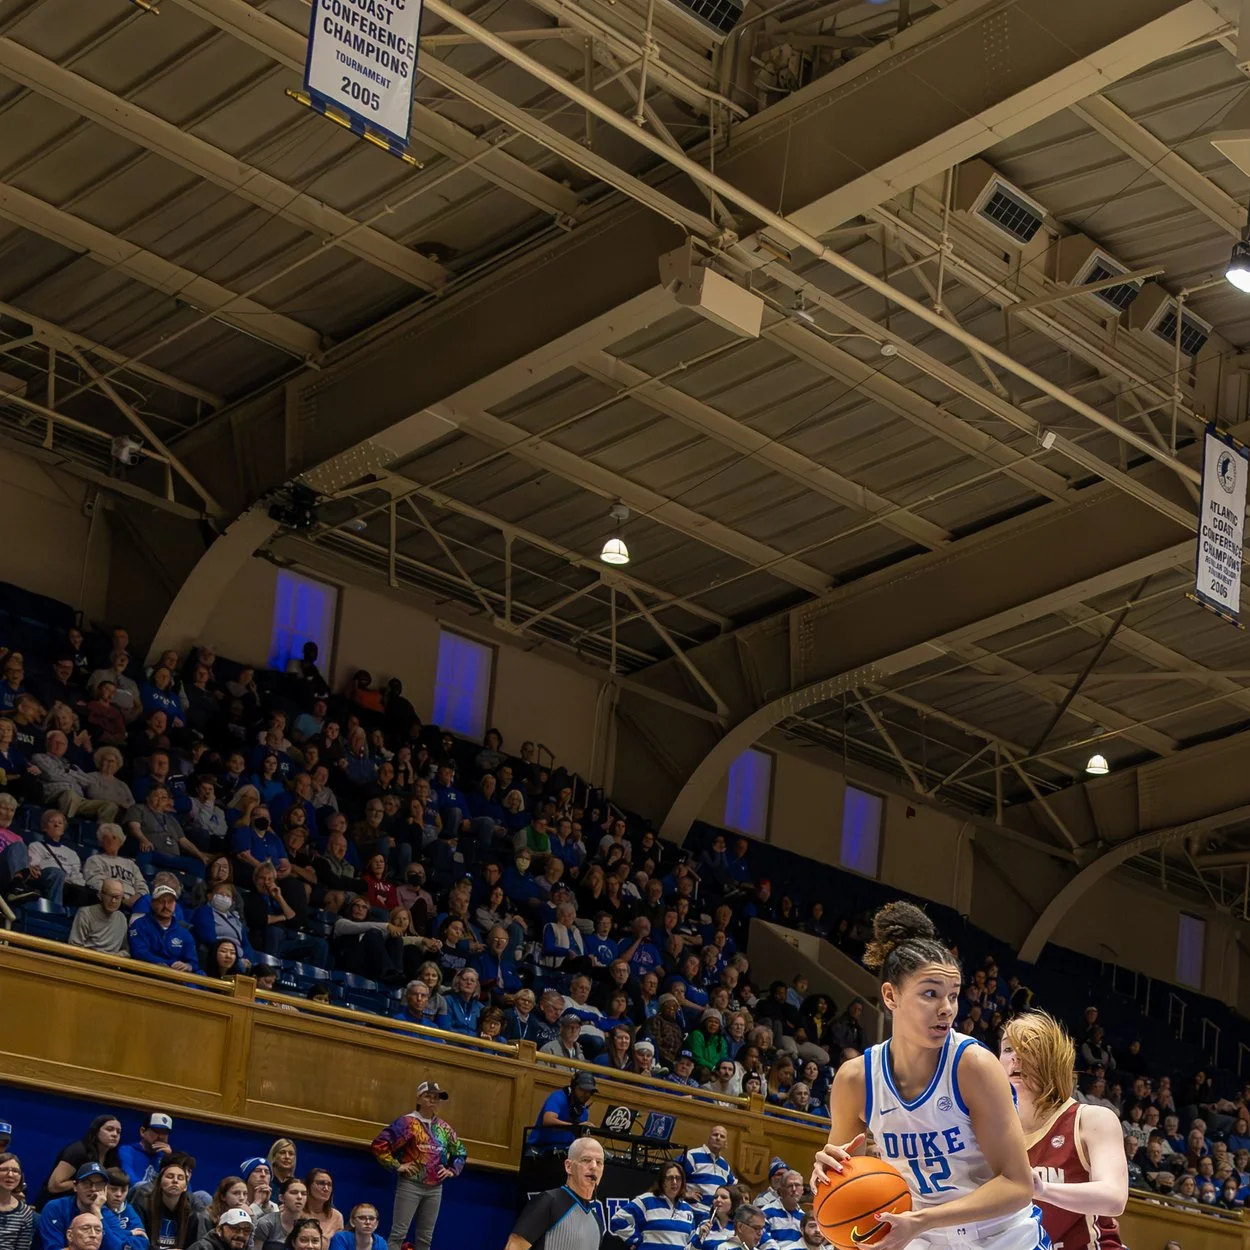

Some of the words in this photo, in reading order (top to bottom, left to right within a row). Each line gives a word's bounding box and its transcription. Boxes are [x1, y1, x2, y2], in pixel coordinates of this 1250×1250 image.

[349, 0, 394, 25] OAST
[321, 0, 415, 61] CONFERENCE
[323, 17, 409, 79] CHAMPIONS
[335, 49, 391, 89] TOURNAMENT
[340, 76, 380, 111] 2005
[1209, 500, 1239, 528] ATLANTIC
[1212, 517, 1234, 540] COAST
[1202, 525, 1243, 560] CONFERENCE
[1203, 541, 1241, 573] CHAMPIONS
[883, 1126, 965, 1158] DUKE
[908, 1156, 959, 1194] 12
